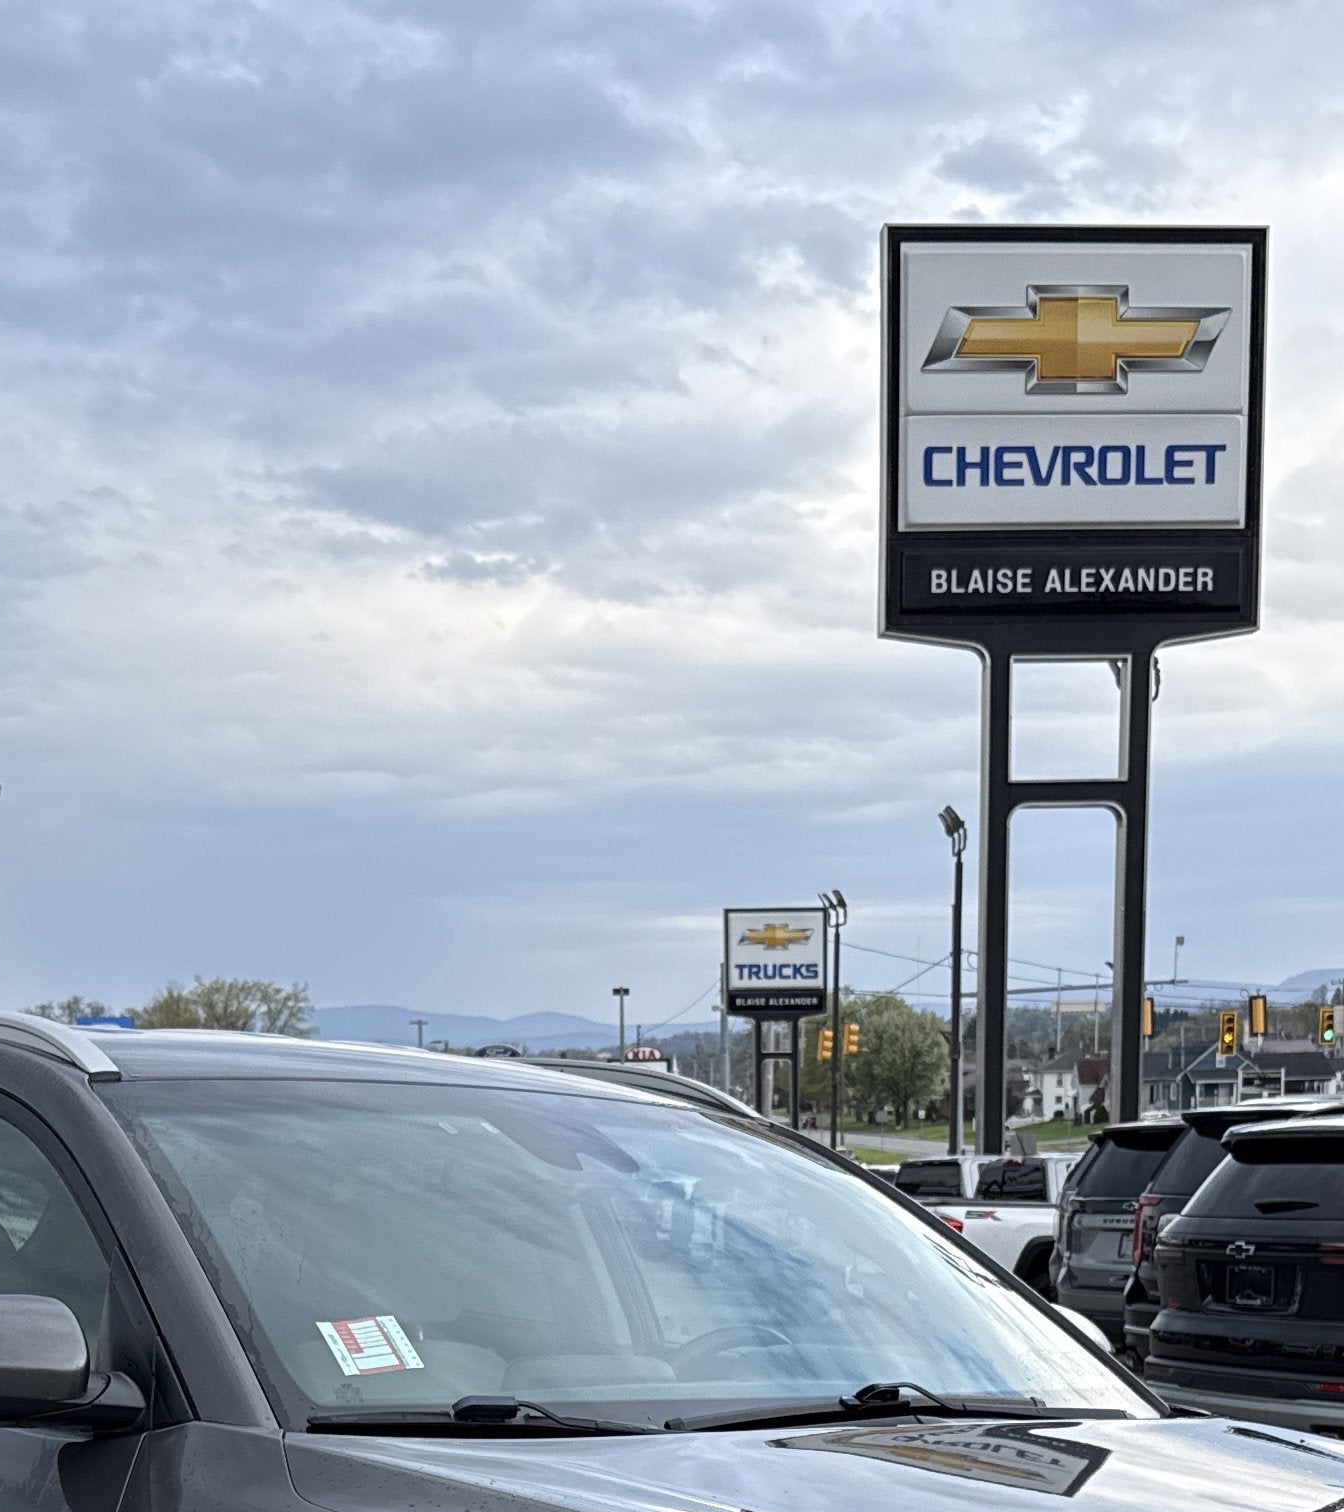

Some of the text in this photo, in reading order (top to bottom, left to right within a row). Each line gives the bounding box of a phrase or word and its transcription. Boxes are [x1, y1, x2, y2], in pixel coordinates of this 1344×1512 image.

[922, 444, 1227, 487] CHEVROLET
[930, 566, 1214, 594] BLAISE ALEXANDER
[734, 963, 819, 980] TRUCKS
[735, 996, 819, 1007] BLAISE ALEXANDER
